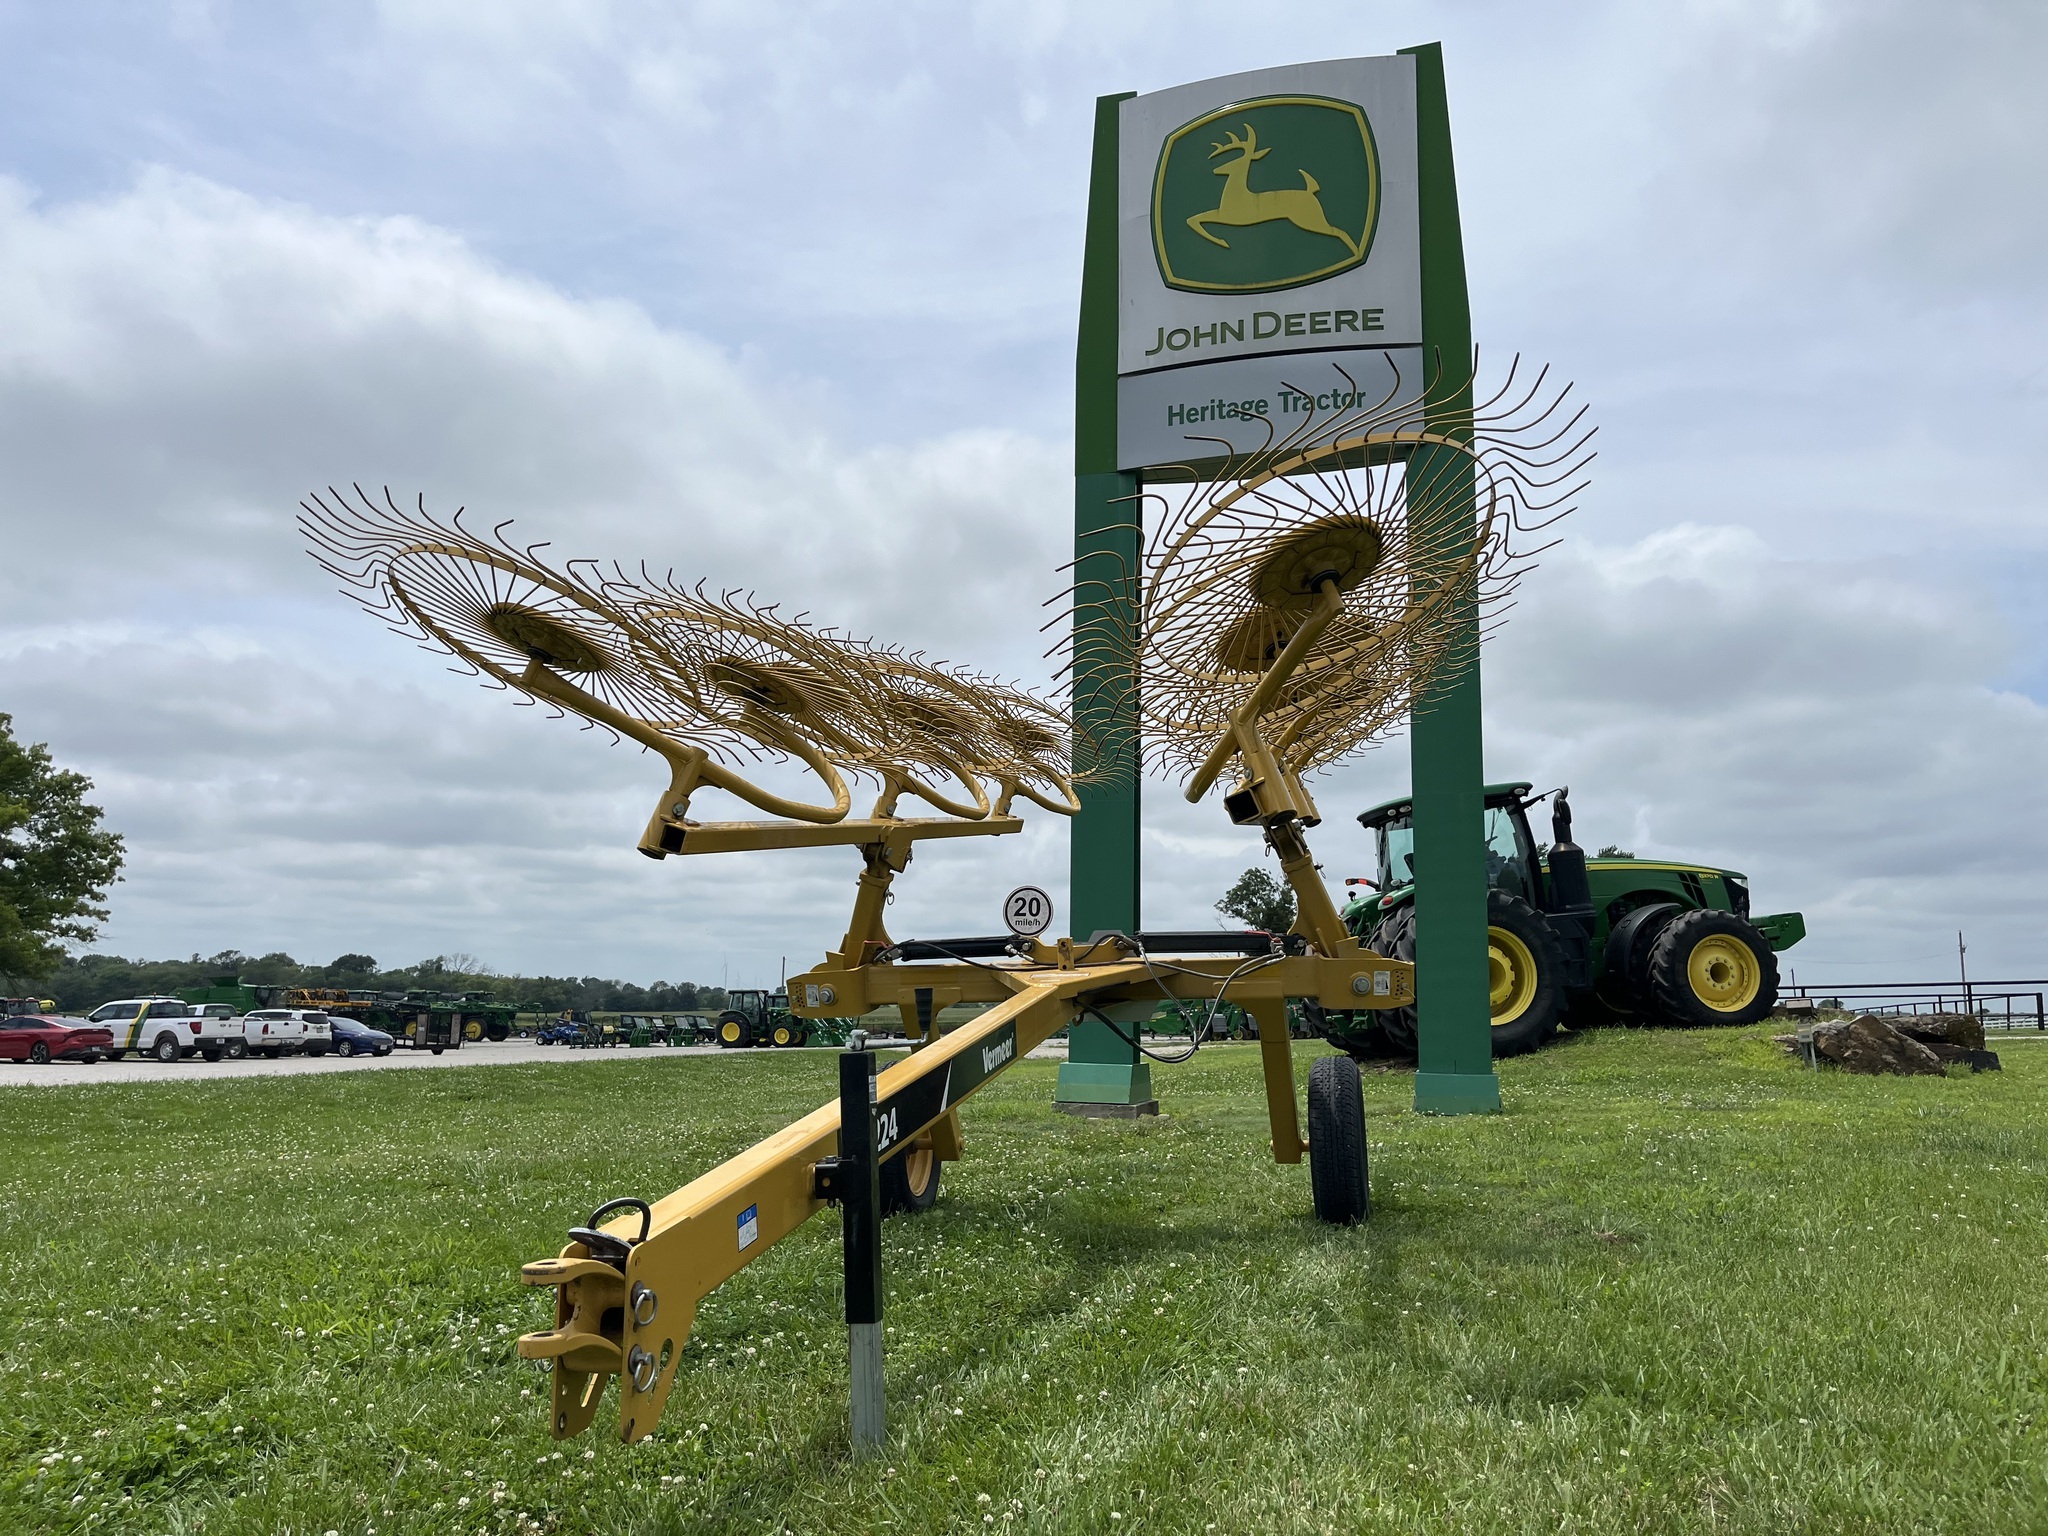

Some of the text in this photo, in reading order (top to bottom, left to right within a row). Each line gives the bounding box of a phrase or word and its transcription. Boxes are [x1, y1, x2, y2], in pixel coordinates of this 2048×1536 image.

[1145, 308, 1385, 356] JOHN DEERE
[1167, 388, 1367, 426] Heritage Tractor
[1013, 897, 1041, 917] 20
[1014, 918, 1041, 927] mile/h
[982, 1037, 1013, 1074] Vermeer
